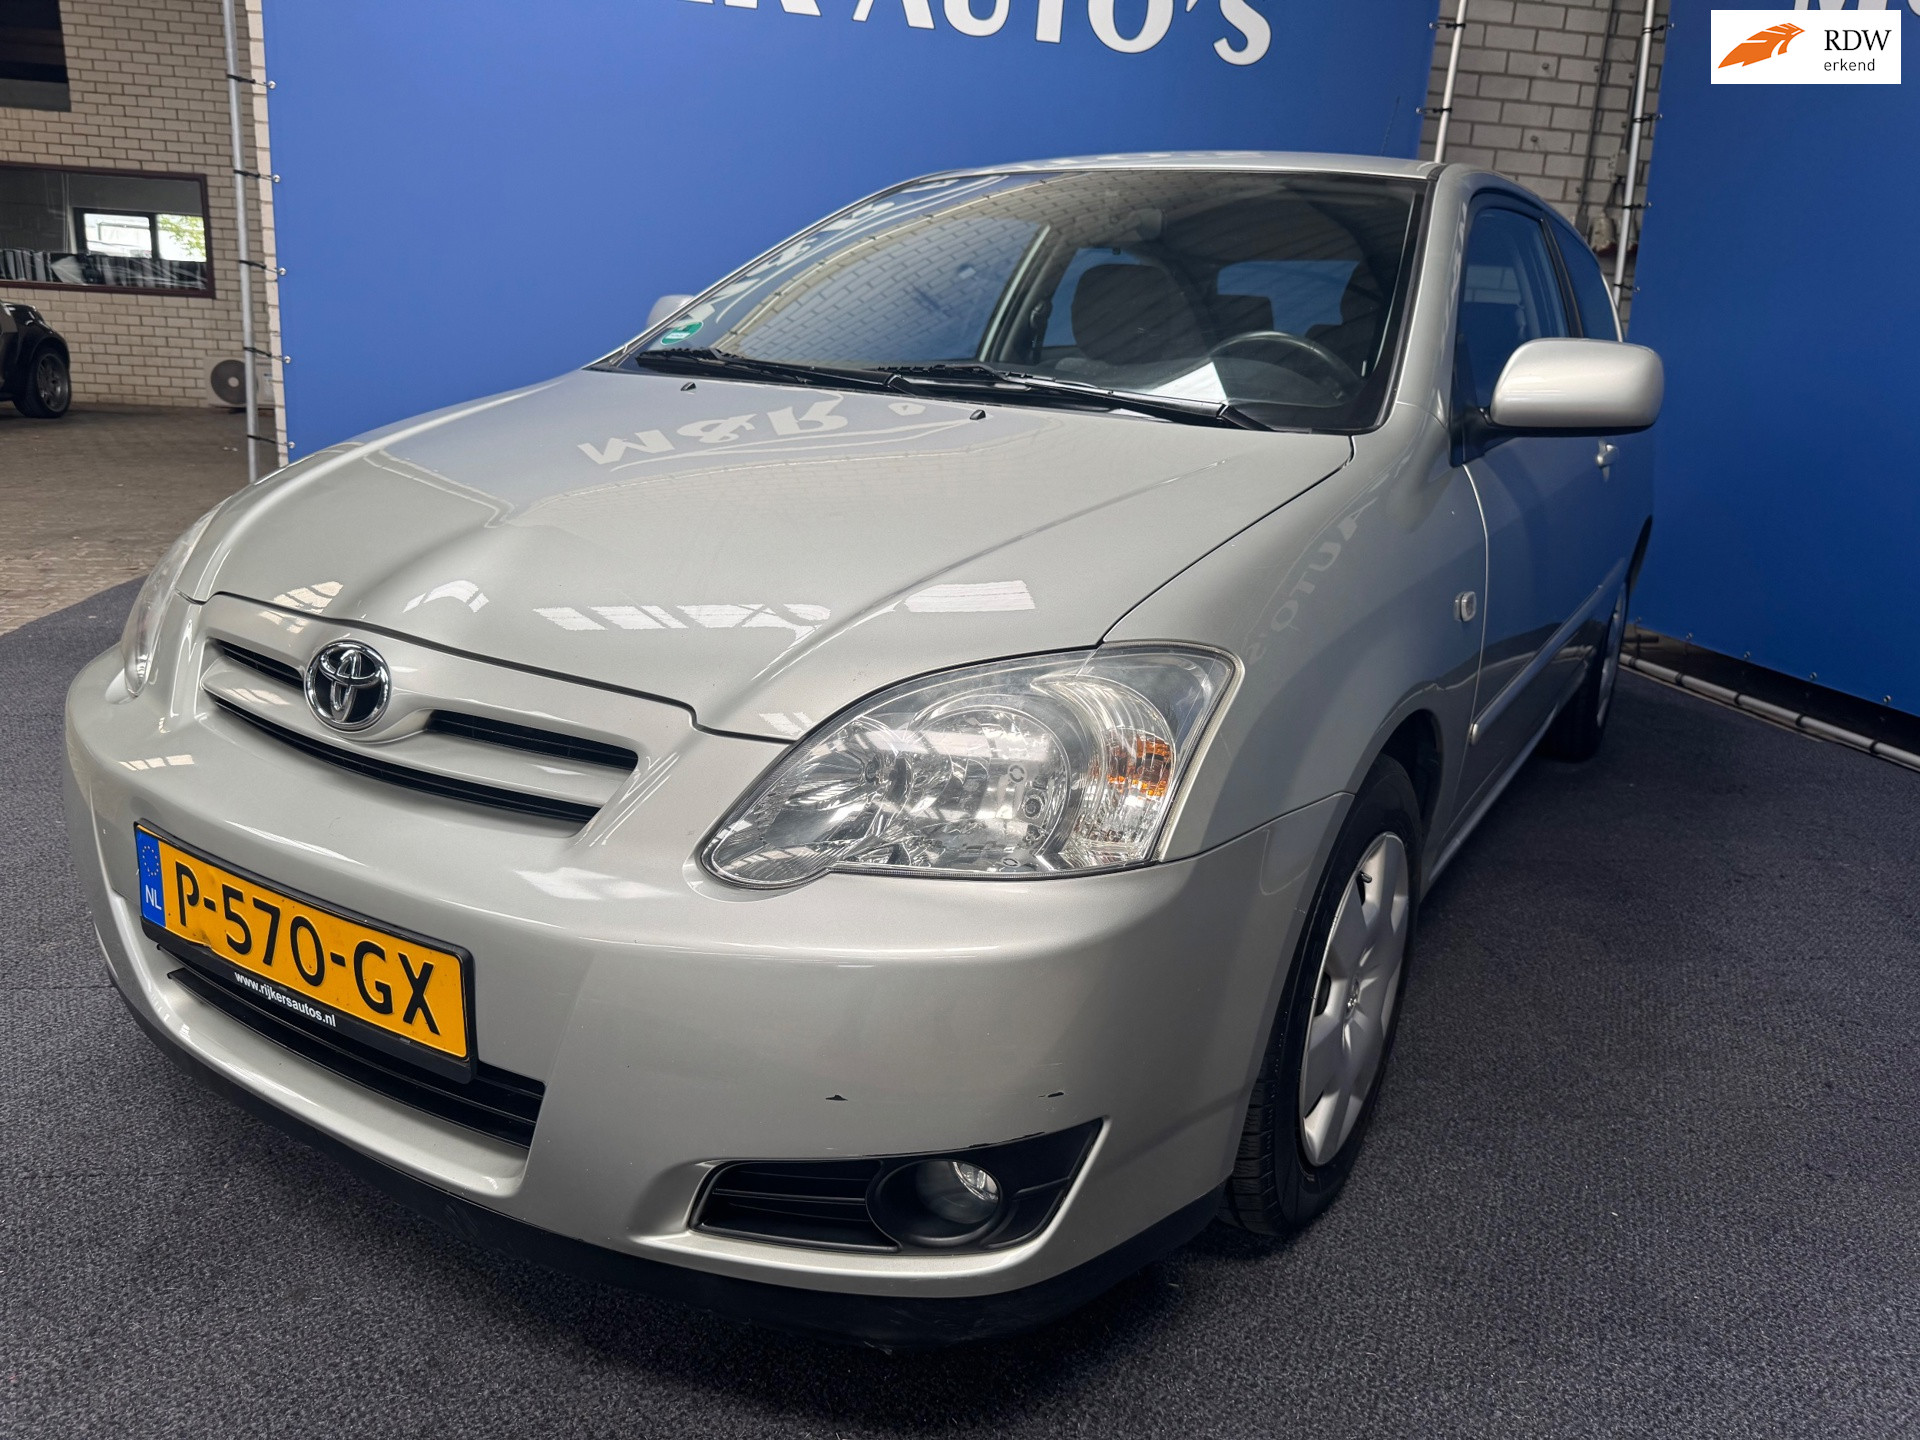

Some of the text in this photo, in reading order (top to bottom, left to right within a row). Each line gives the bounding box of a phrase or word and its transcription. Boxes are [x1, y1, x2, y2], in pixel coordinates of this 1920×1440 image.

[145, 884, 162, 911] NL
[175, 860, 441, 1036] P-570-GX
[234, 971, 337, 1028] www.rijkersautos.nl
